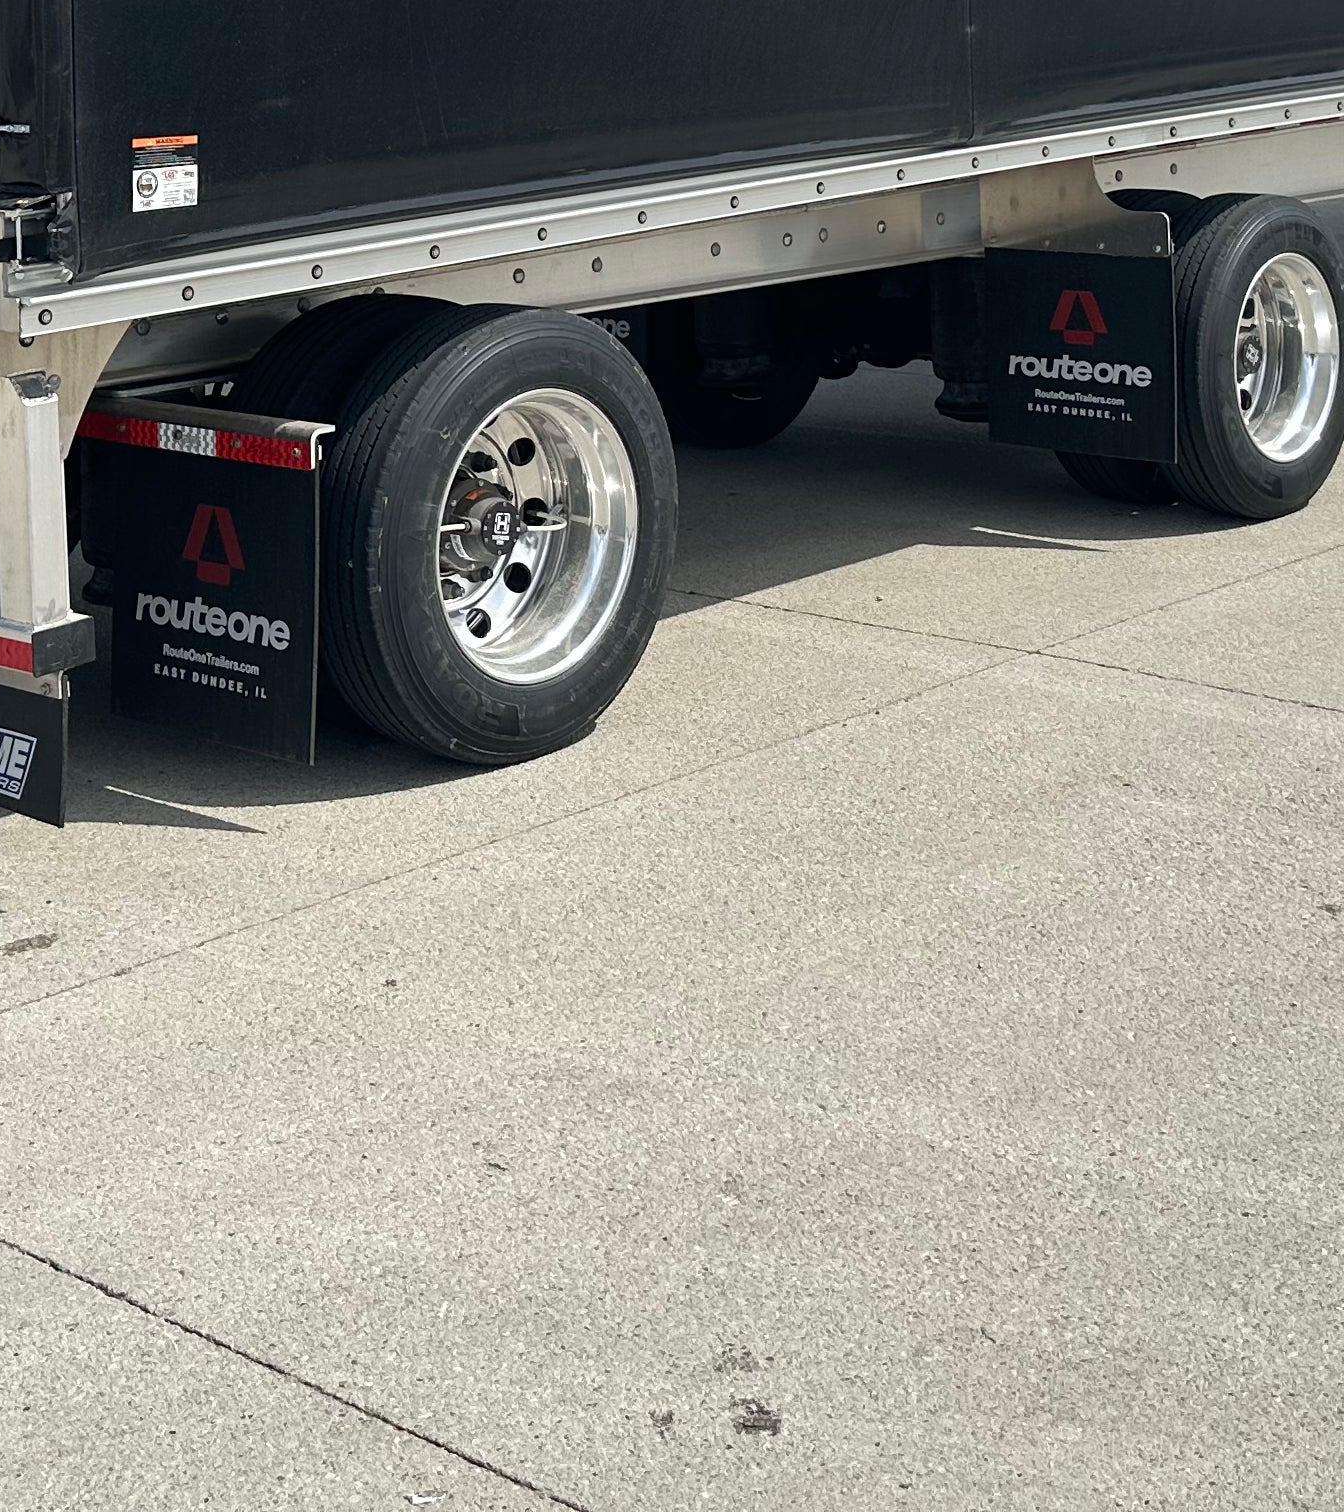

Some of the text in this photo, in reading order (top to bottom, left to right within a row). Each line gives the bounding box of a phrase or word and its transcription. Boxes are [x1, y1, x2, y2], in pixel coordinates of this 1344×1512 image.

[1008, 354, 1153, 388] routeone
[1027, 402, 1133, 422] EAST DUNDEE, IL
[1034, 388, 1125, 407] RouteOneTrailers.com
[135, 592, 291, 651] routeone
[162, 643, 260, 676] RouteOneTrailers.com
[154, 663, 268, 700] EAST DUNDEE, IL
